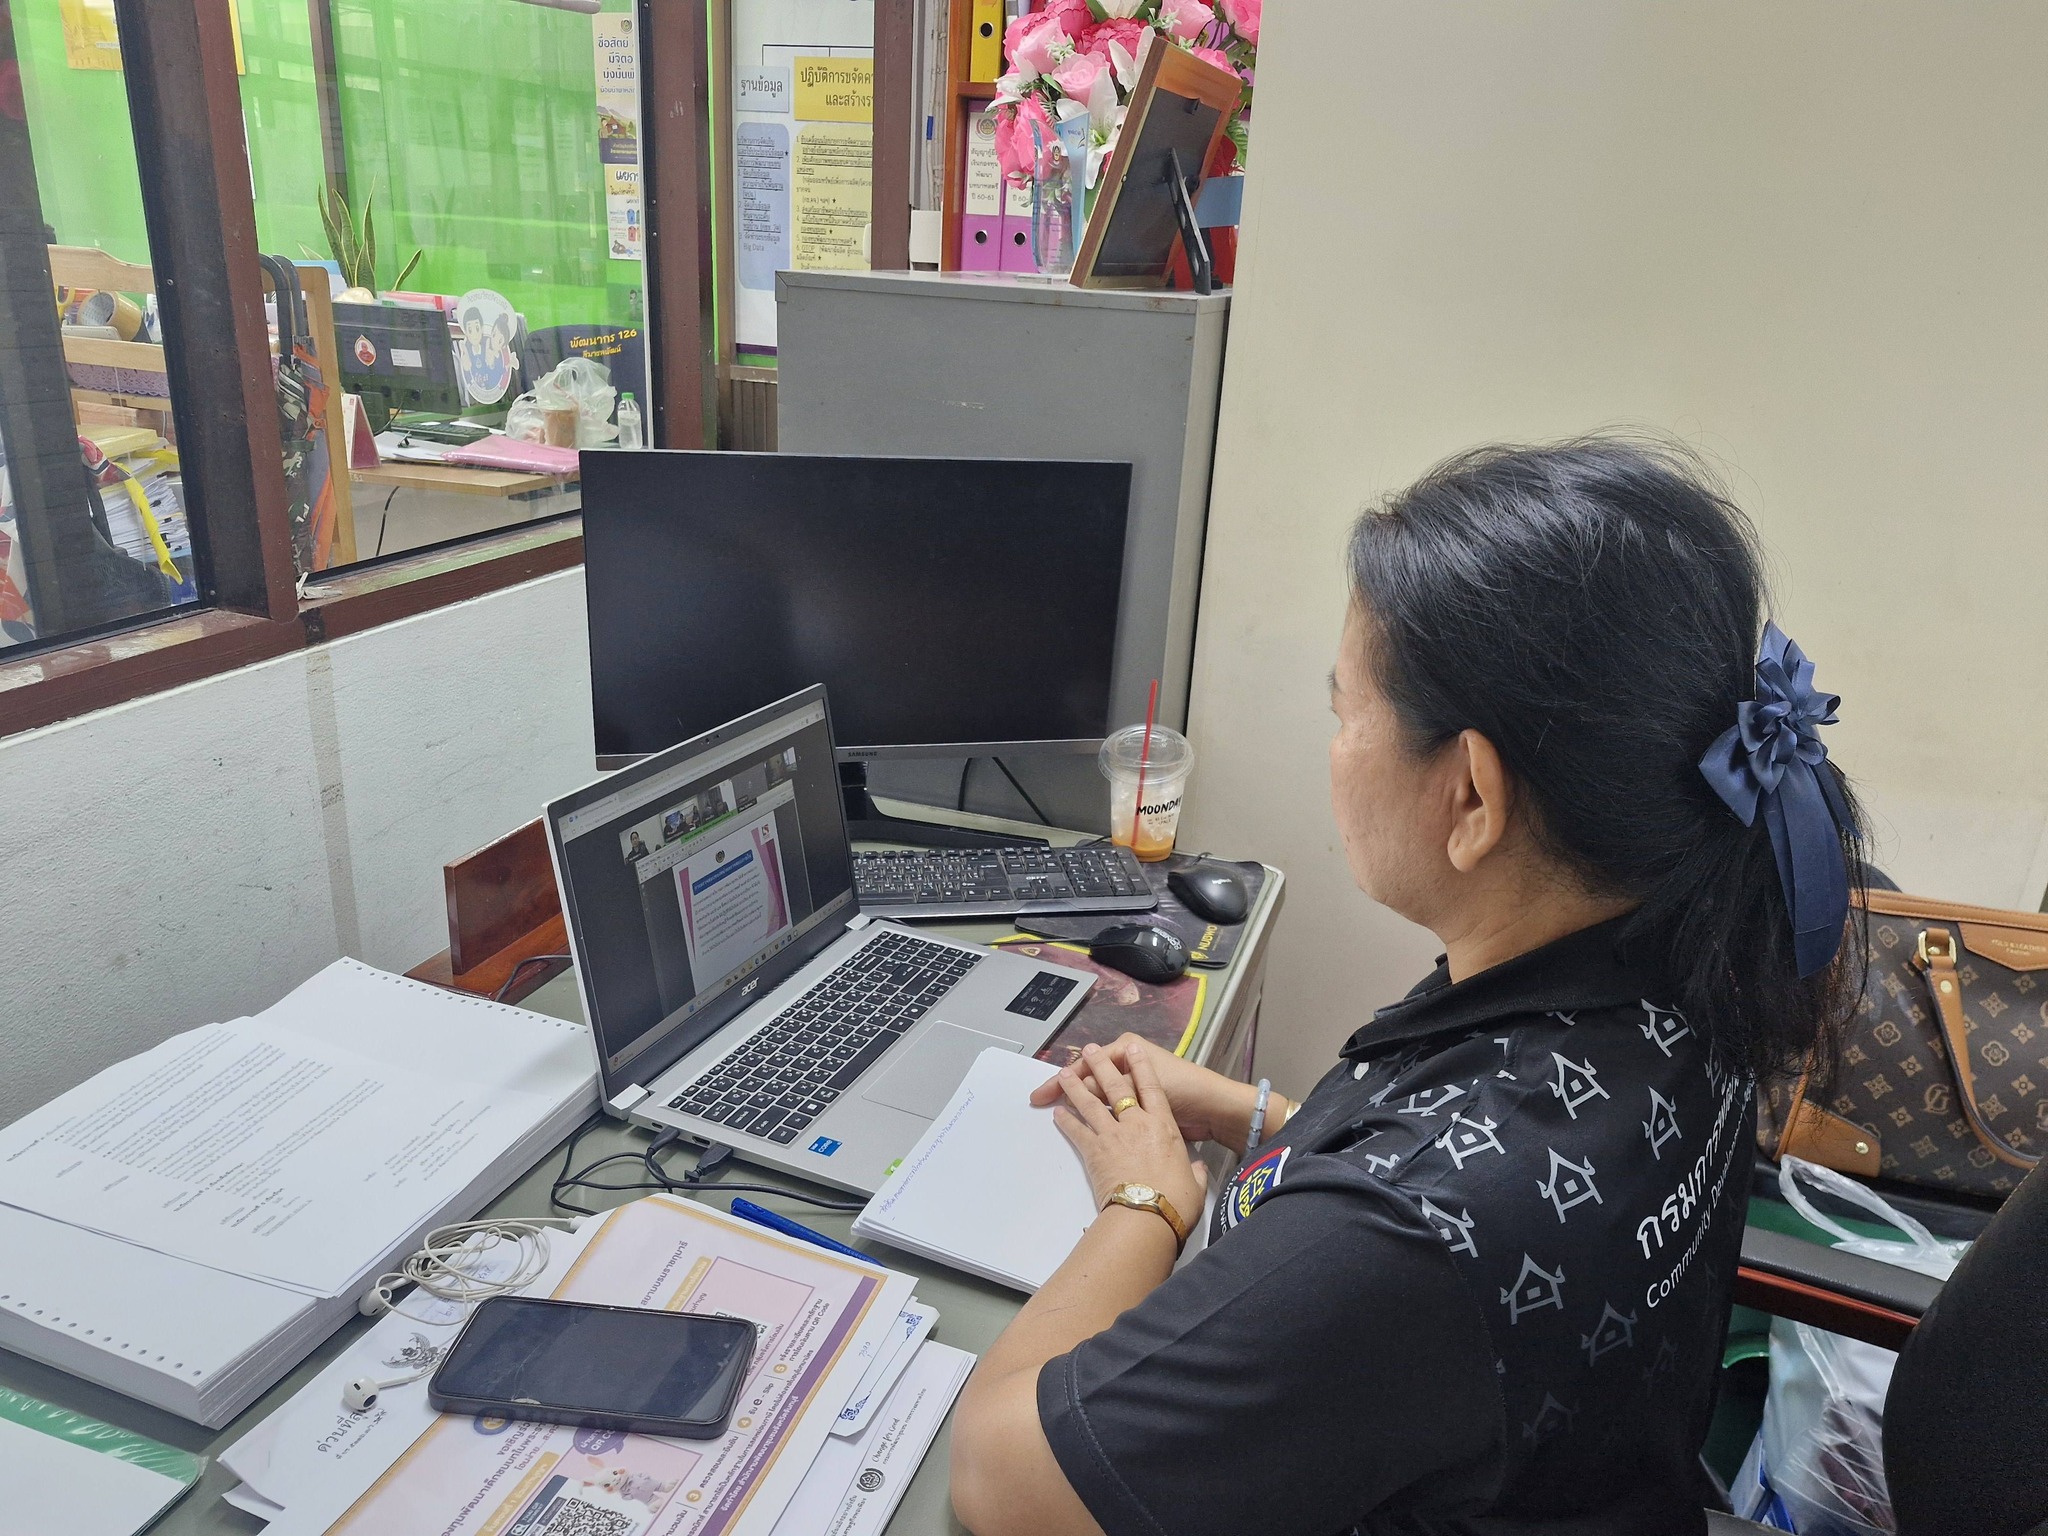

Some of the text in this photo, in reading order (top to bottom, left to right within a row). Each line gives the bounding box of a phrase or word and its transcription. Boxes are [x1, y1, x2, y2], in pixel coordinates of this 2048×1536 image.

[740, 75, 783, 98] ฐานข้อมูล
[570, 328, 637, 349] พัฒนากร 126
[741, 977, 760, 997] acer
[1646, 1203, 1712, 1308] Community
[811, 1315, 820, 1326] QR
[817, 1301, 829, 1317] Code
[317, 1407, 366, 1455] ด่วนที่สุ
[496, 1419, 531, 1457] ขอเชิญร่ว
